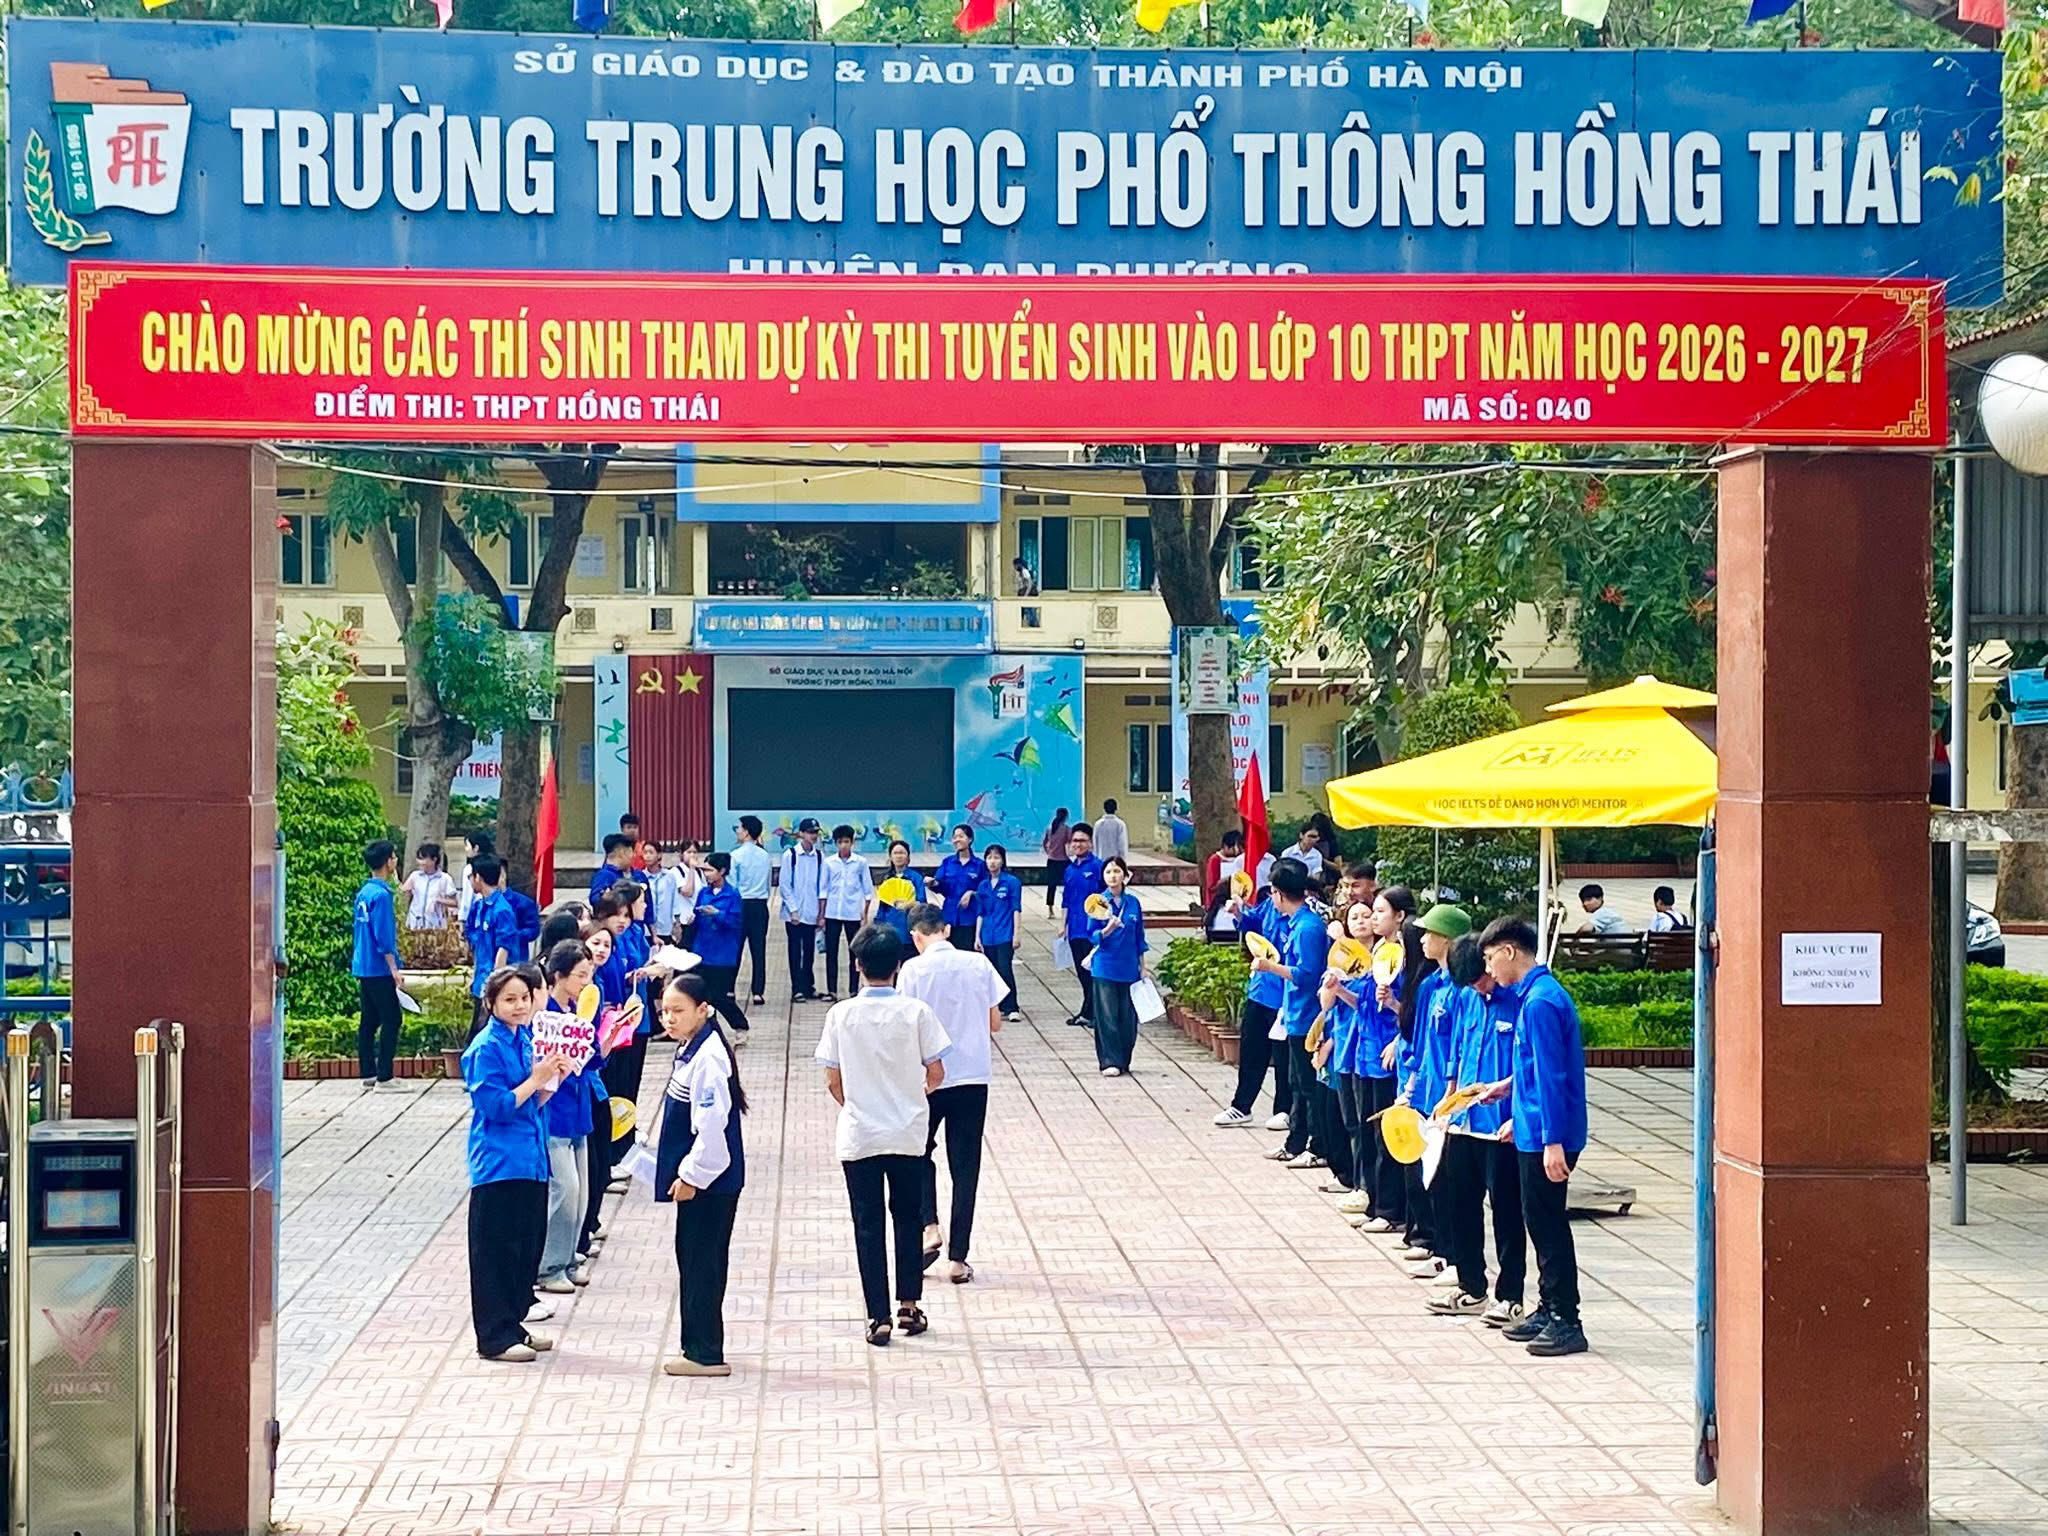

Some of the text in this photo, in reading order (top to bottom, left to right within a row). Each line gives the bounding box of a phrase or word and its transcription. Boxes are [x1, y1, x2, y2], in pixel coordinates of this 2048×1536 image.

[513, 42, 1523, 93] SỞ GIÁO DỤC & ĐÀO TẠO THÀNH PHỐ HÀ NỘI
[230, 84, 1921, 244] TRƯỜNG TRUNG HỌC PHỔ THÔNG HỒNG THÁI
[142, 298, 1868, 394] CHÀO MỪNG CÁC THÍ SINH THAM DỰ KỲ THI TUYỂN SINH VÀO LỚP 10 THPT NĂM HỌC 2026 - 2027
[314, 383, 396, 417] ĐIỂM
[403, 394, 464, 418] THI:
[472, 395, 550, 420] THPT
[650, 391, 721, 421] THÁI
[1423, 389, 1592, 421] MÃ SỐ: 040
